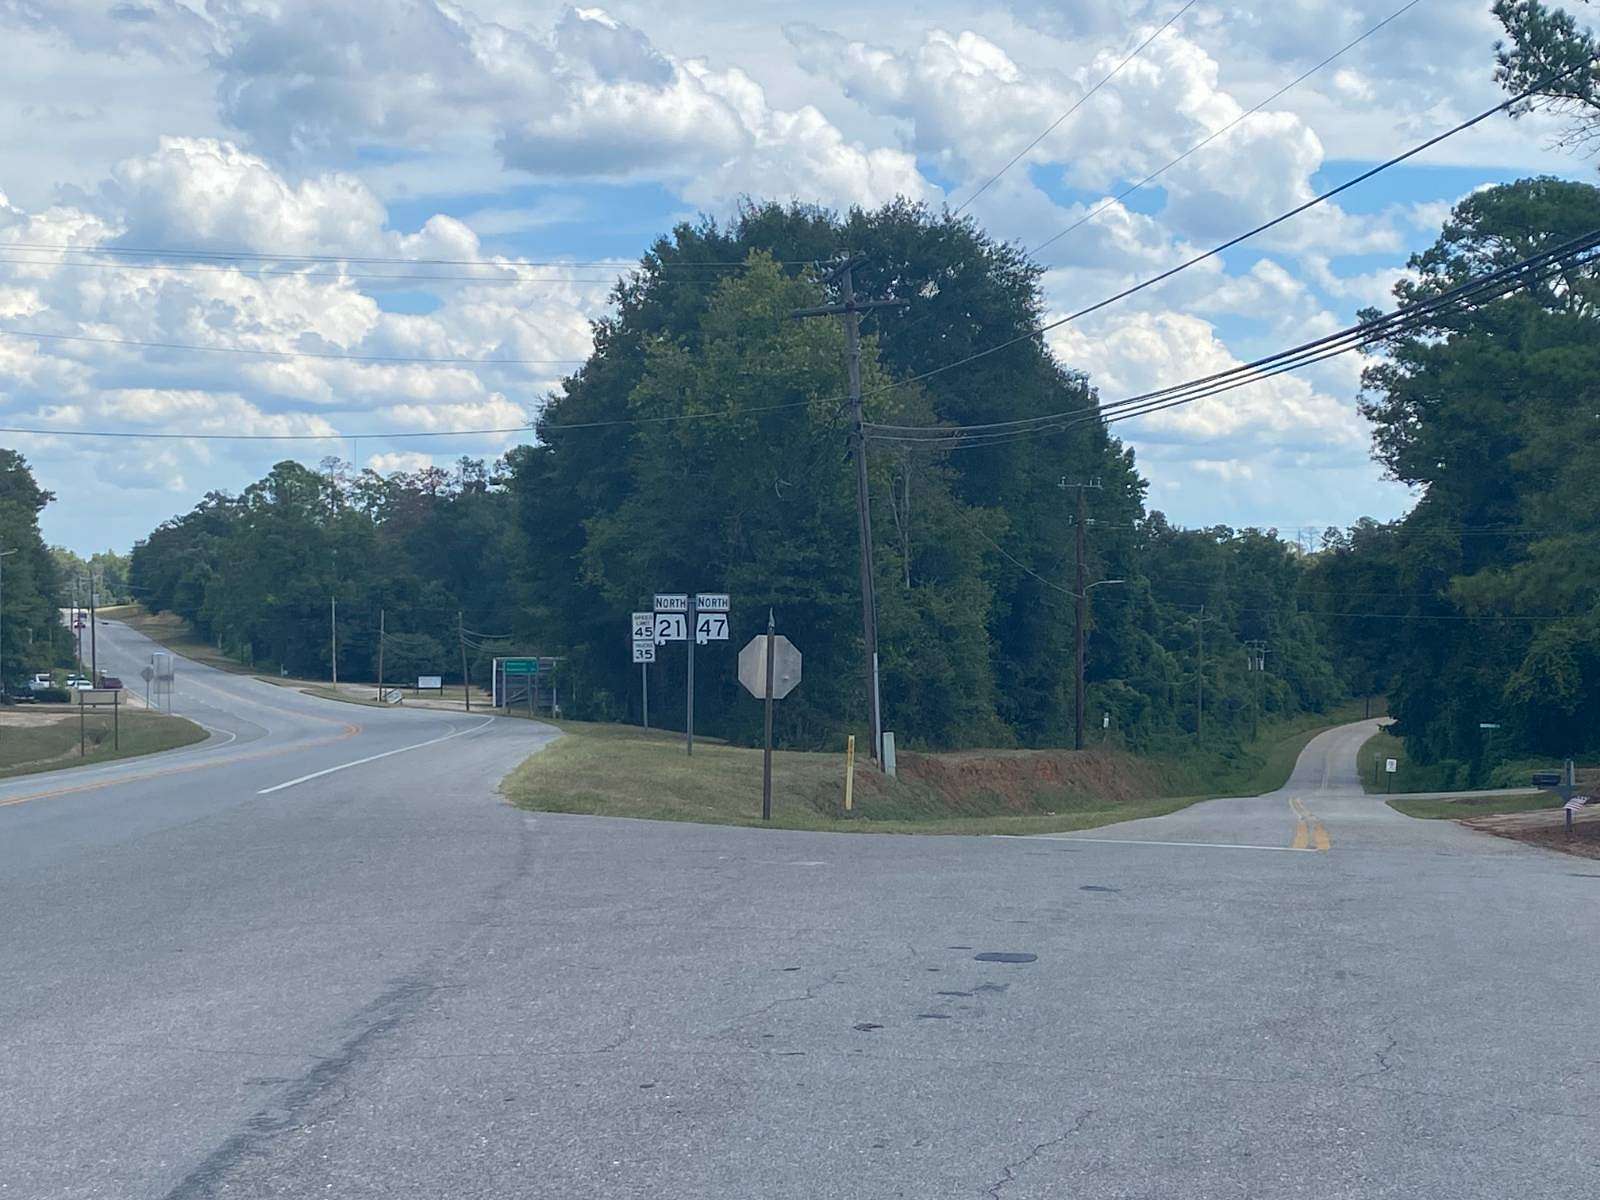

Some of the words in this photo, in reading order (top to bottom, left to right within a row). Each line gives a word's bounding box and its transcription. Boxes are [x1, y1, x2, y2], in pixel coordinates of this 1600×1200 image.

[656, 597, 686, 609] NORTH
[698, 596, 728, 608] NORTH
[634, 626, 653, 637] 45
[659, 619, 681, 637] 21
[698, 619, 725, 637] 47
[635, 649, 653, 660] 35
